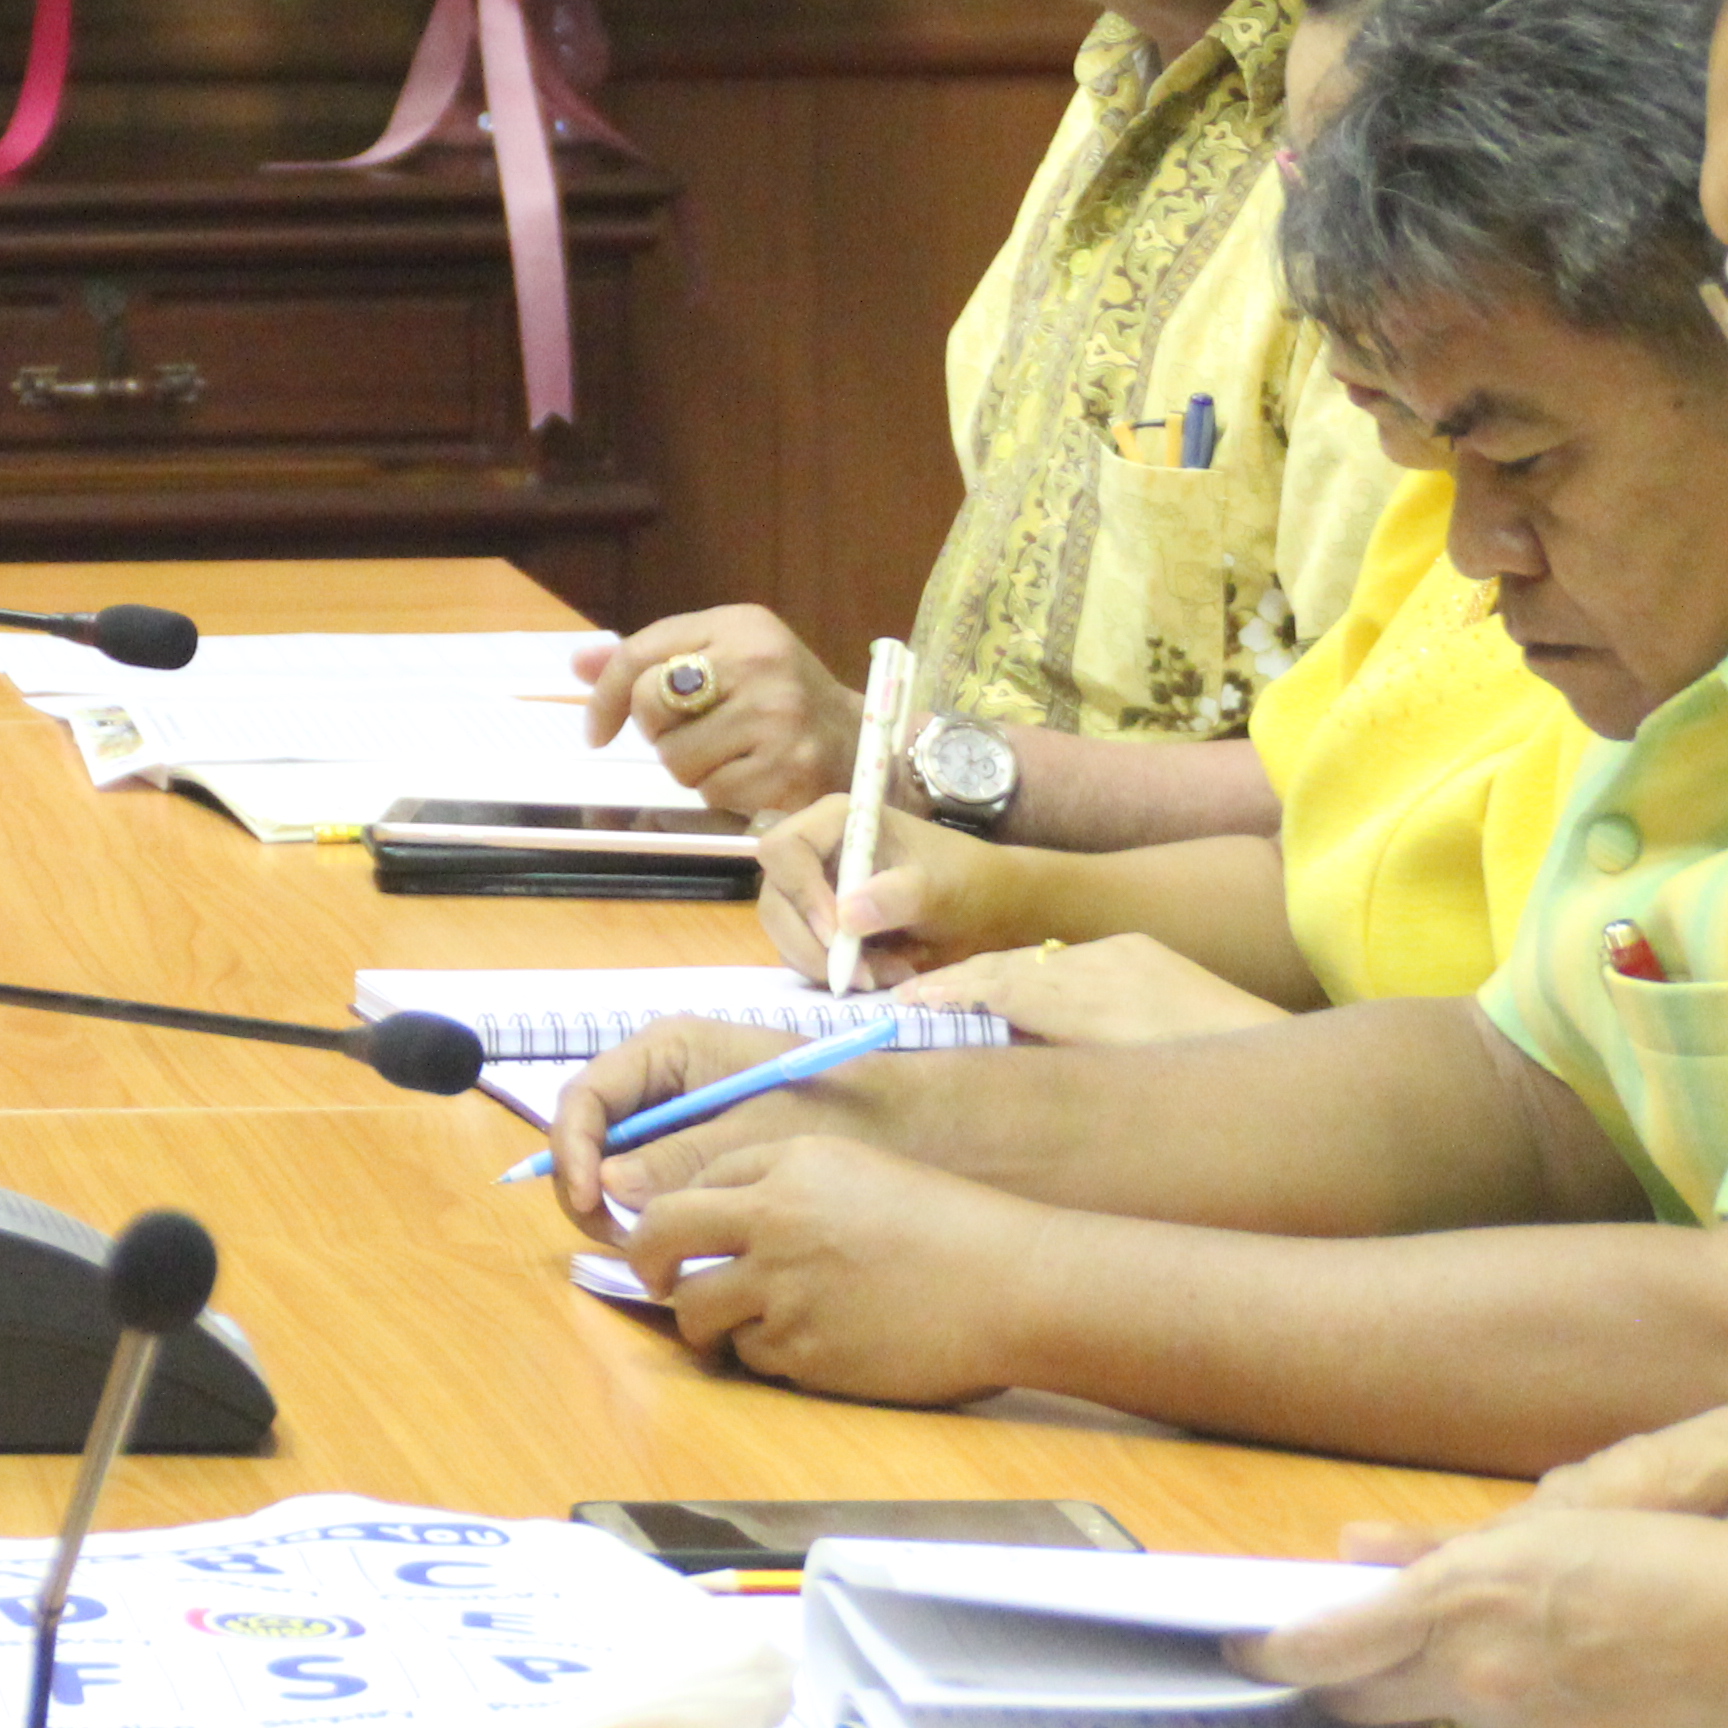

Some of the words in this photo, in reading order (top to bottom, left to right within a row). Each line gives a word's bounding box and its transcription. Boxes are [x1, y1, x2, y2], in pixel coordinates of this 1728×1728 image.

[378, 1523, 504, 1546] YOU
[394, 1560, 498, 1589] C
[461, 1610, 536, 1635] E
[48, 1661, 122, 1706] F
[265, 1654, 369, 1701] S
[492, 1655, 592, 1684] P
